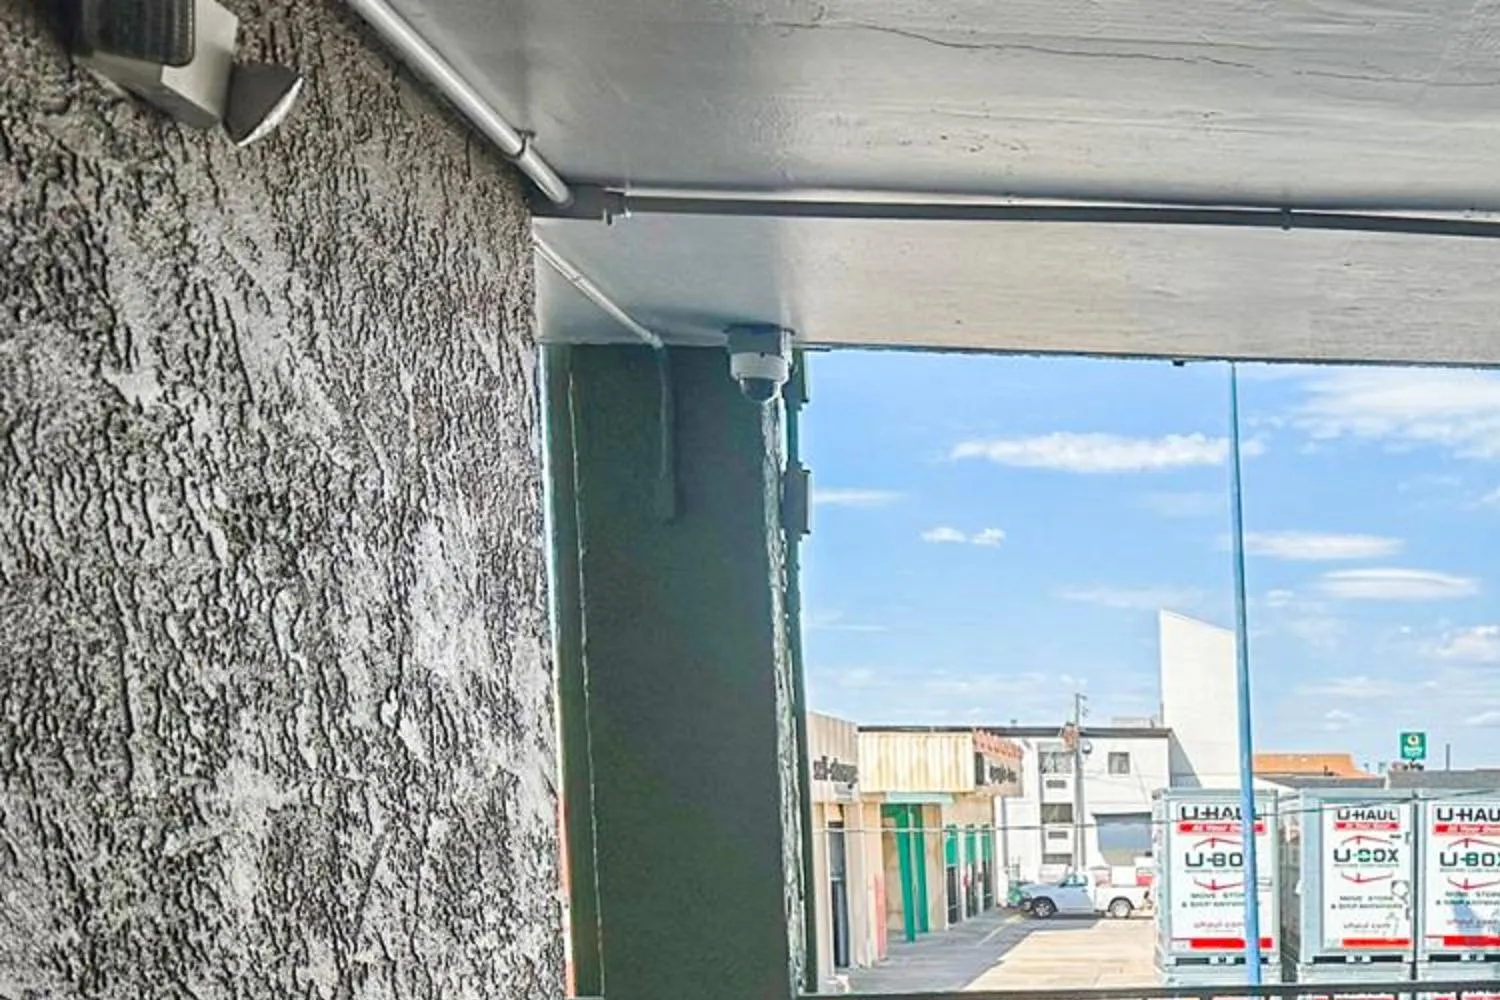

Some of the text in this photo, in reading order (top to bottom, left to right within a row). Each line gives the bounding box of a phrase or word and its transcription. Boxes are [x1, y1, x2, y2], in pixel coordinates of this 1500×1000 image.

[1337, 809, 1397, 821] U-HAUL
[1185, 852, 1244, 867] U-BO
[1333, 848, 1399, 863] U-BOX
